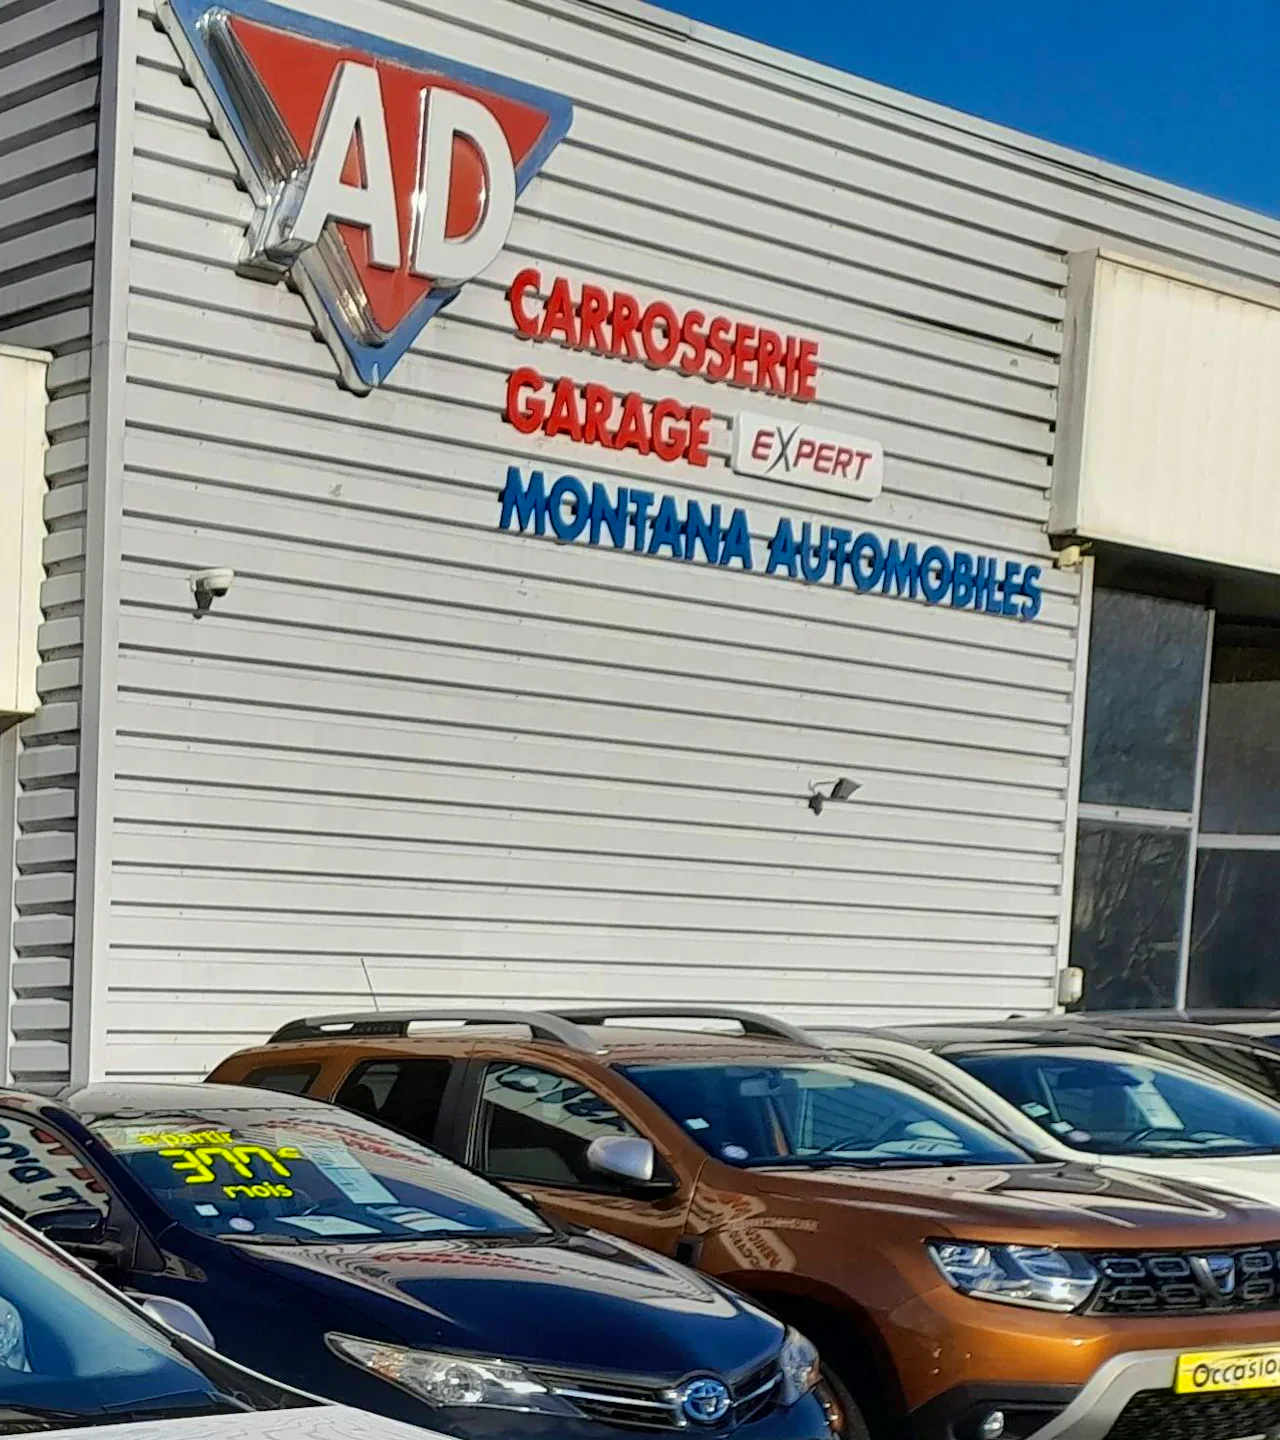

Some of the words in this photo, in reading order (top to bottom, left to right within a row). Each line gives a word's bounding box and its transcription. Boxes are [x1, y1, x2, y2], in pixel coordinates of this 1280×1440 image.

[289, 60, 517, 288] AD
[508, 267, 820, 401] CARROSSERIE
[505, 367, 711, 468] GARAGE
[751, 422, 873, 480] EXPERT
[500, 466, 752, 573] MONTANA
[766, 518, 1042, 621] AUTOMOBILES
[159, 1130, 234, 1147] partir
[1193, 1359, 1280, 1388] Occasio
